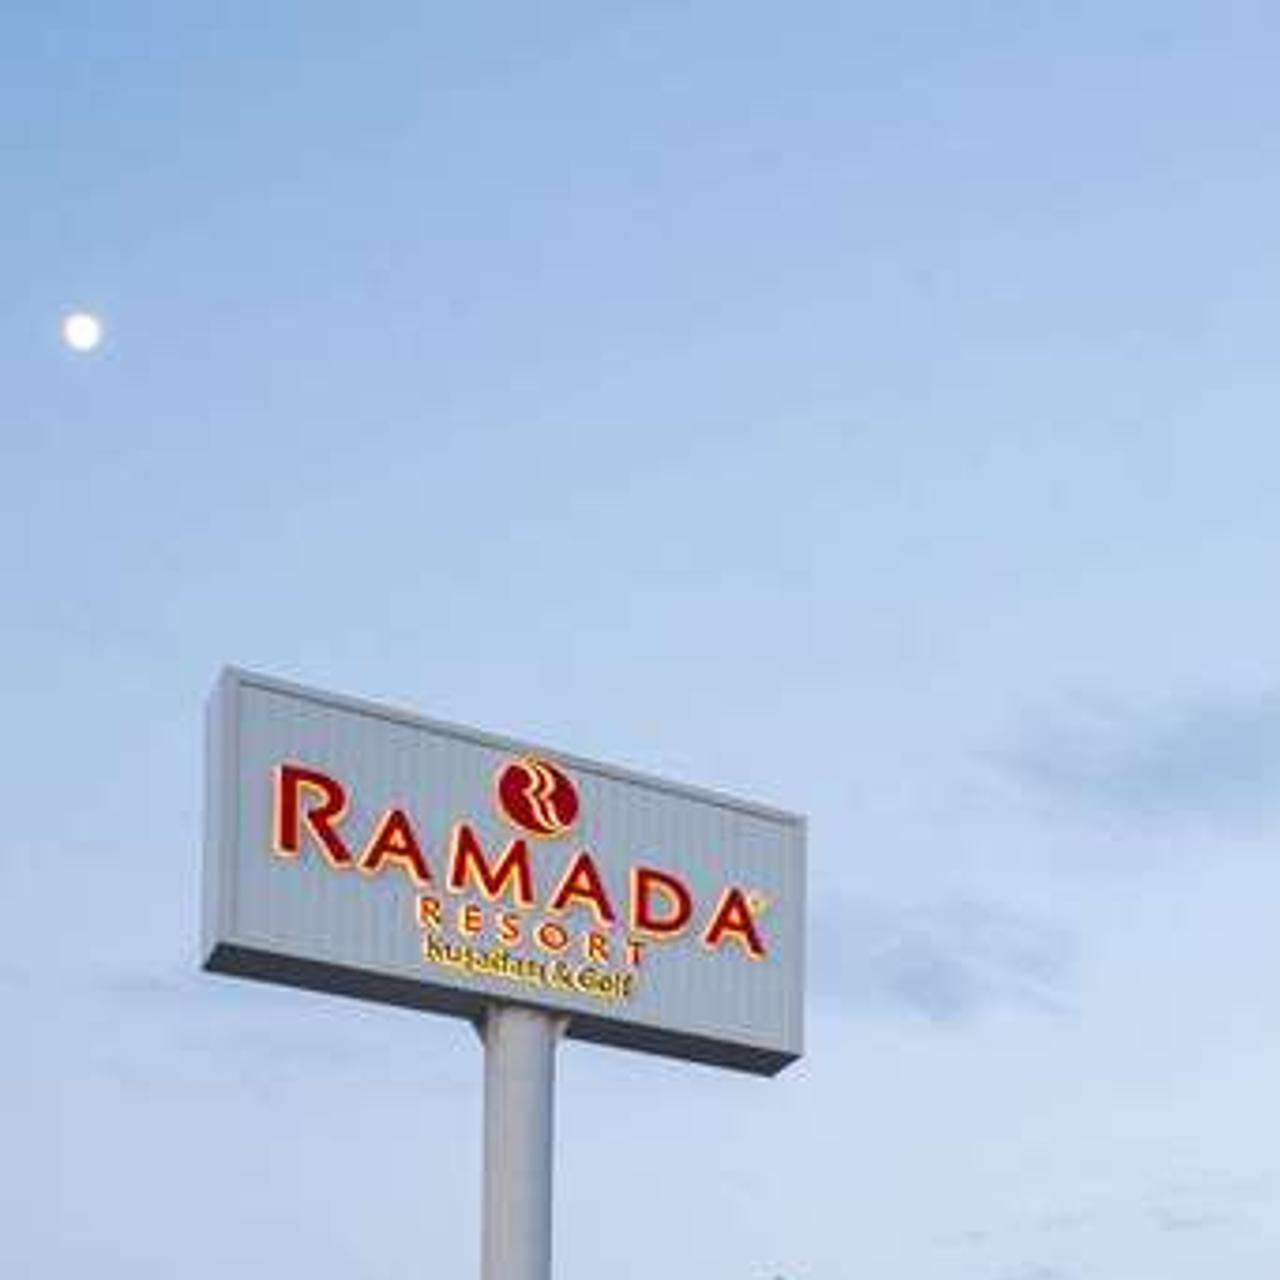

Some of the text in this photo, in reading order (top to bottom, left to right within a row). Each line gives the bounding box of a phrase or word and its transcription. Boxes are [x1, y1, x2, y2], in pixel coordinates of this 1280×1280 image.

[272, 761, 768, 956] RAMADA
[418, 896, 646, 965] RESORT
[577, 966, 634, 998] Golf
